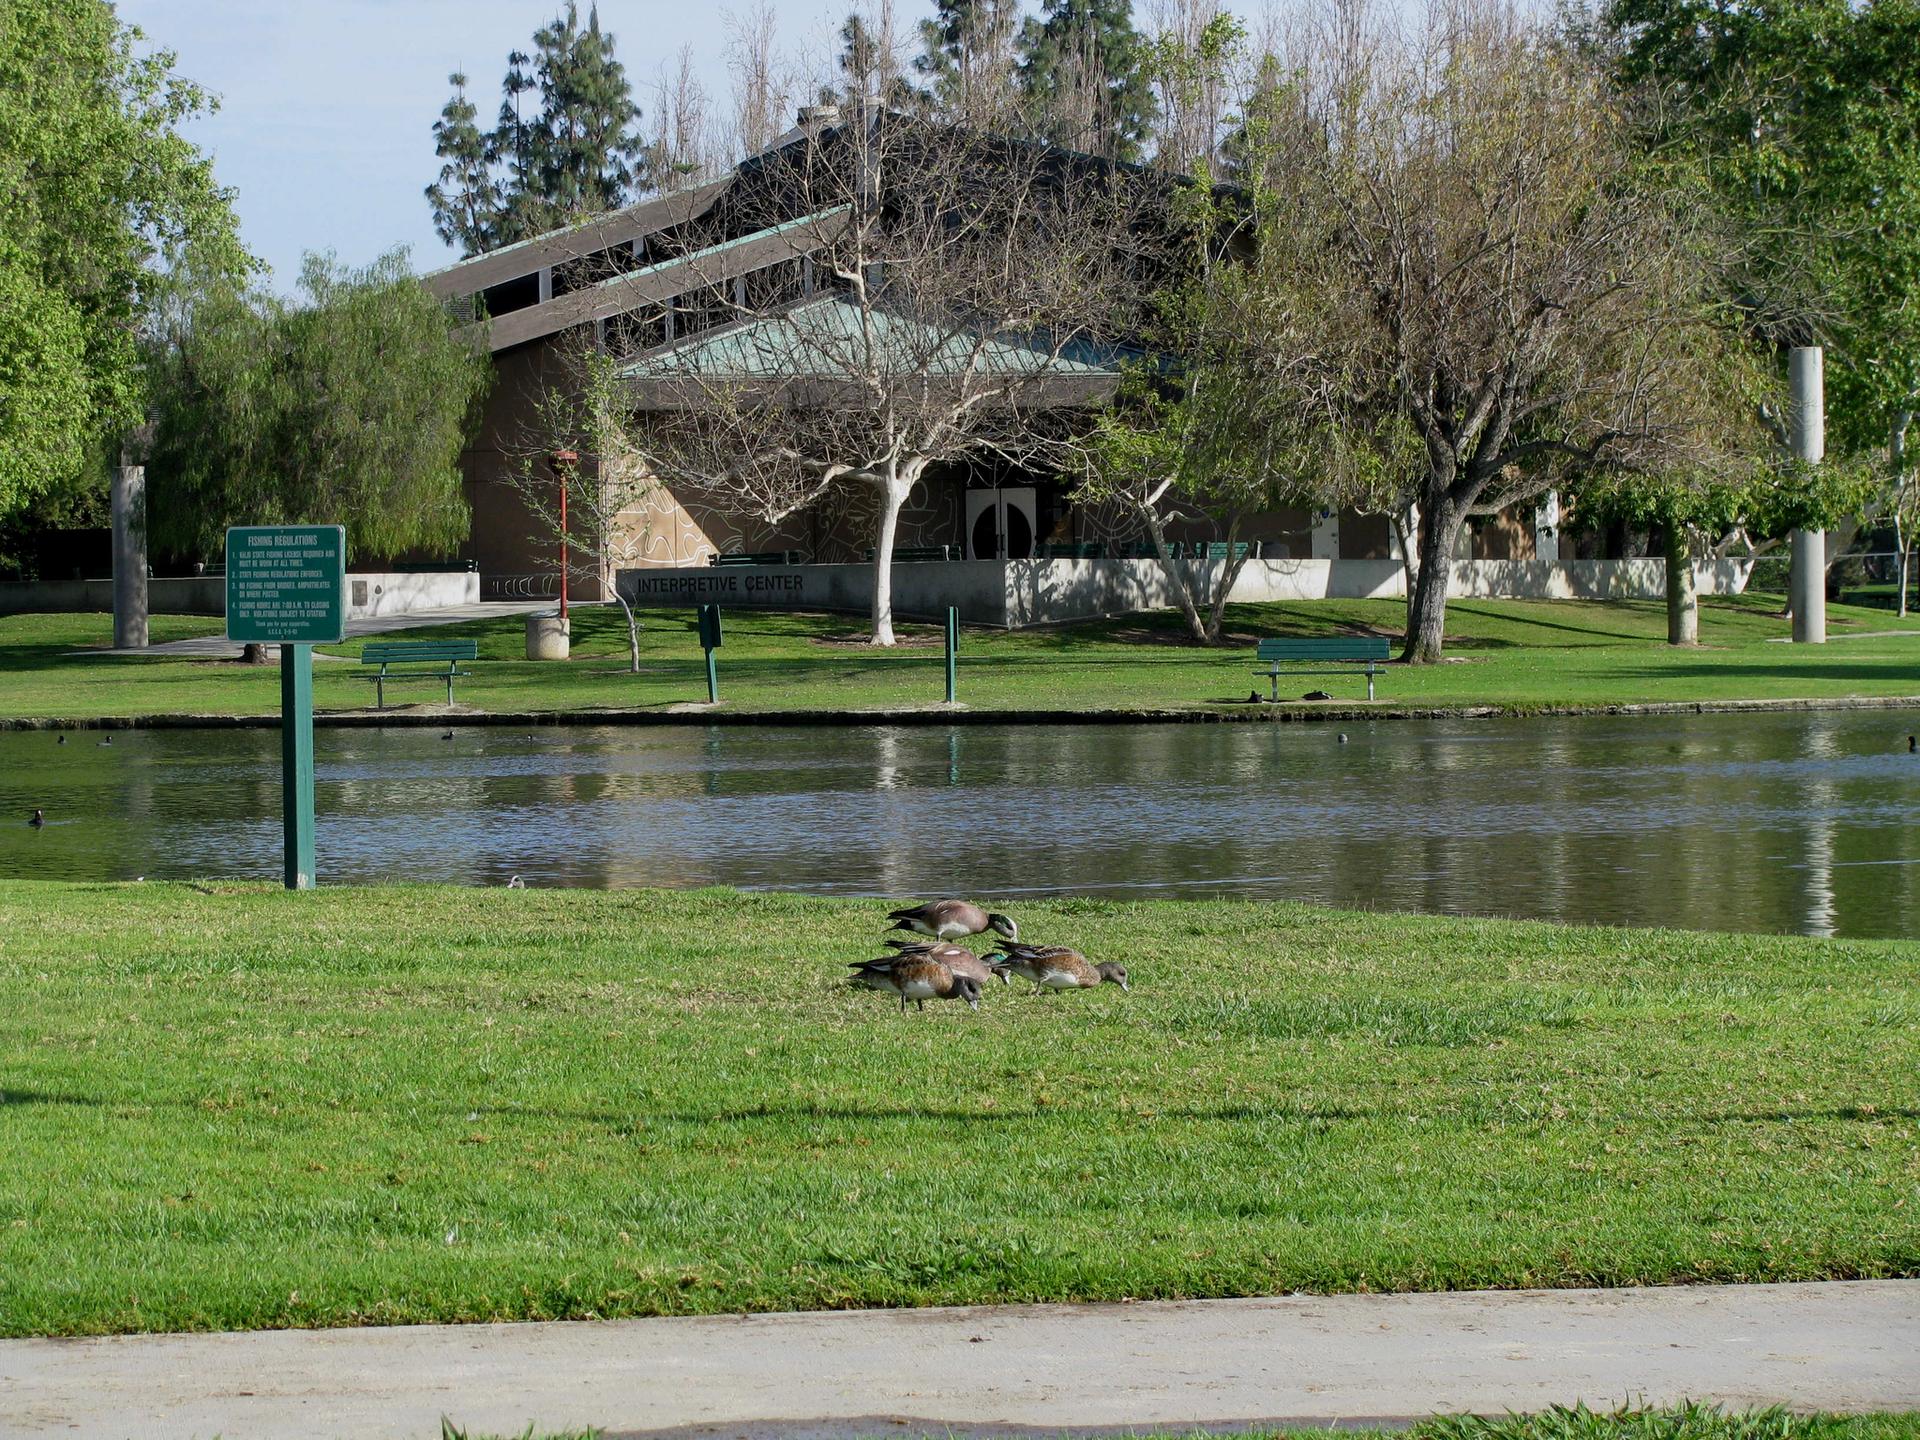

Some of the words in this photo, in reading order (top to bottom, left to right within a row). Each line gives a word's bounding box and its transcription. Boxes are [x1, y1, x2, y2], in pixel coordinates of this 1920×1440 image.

[248, 535, 272, 547] FISHING
[274, 534, 318, 546] REGULATIONS
[266, 551, 283, 559] FISHING
[284, 550, 302, 558] LICENSE
[270, 570, 299, 578] REGULATIONS
[638, 576, 737, 593] INTERPRETIVE
[744, 575, 803, 591] CENTER
[239, 601, 256, 609] FISHING
[278, 610, 298, 618] SUBJECT
[299, 610, 305, 618] TO
